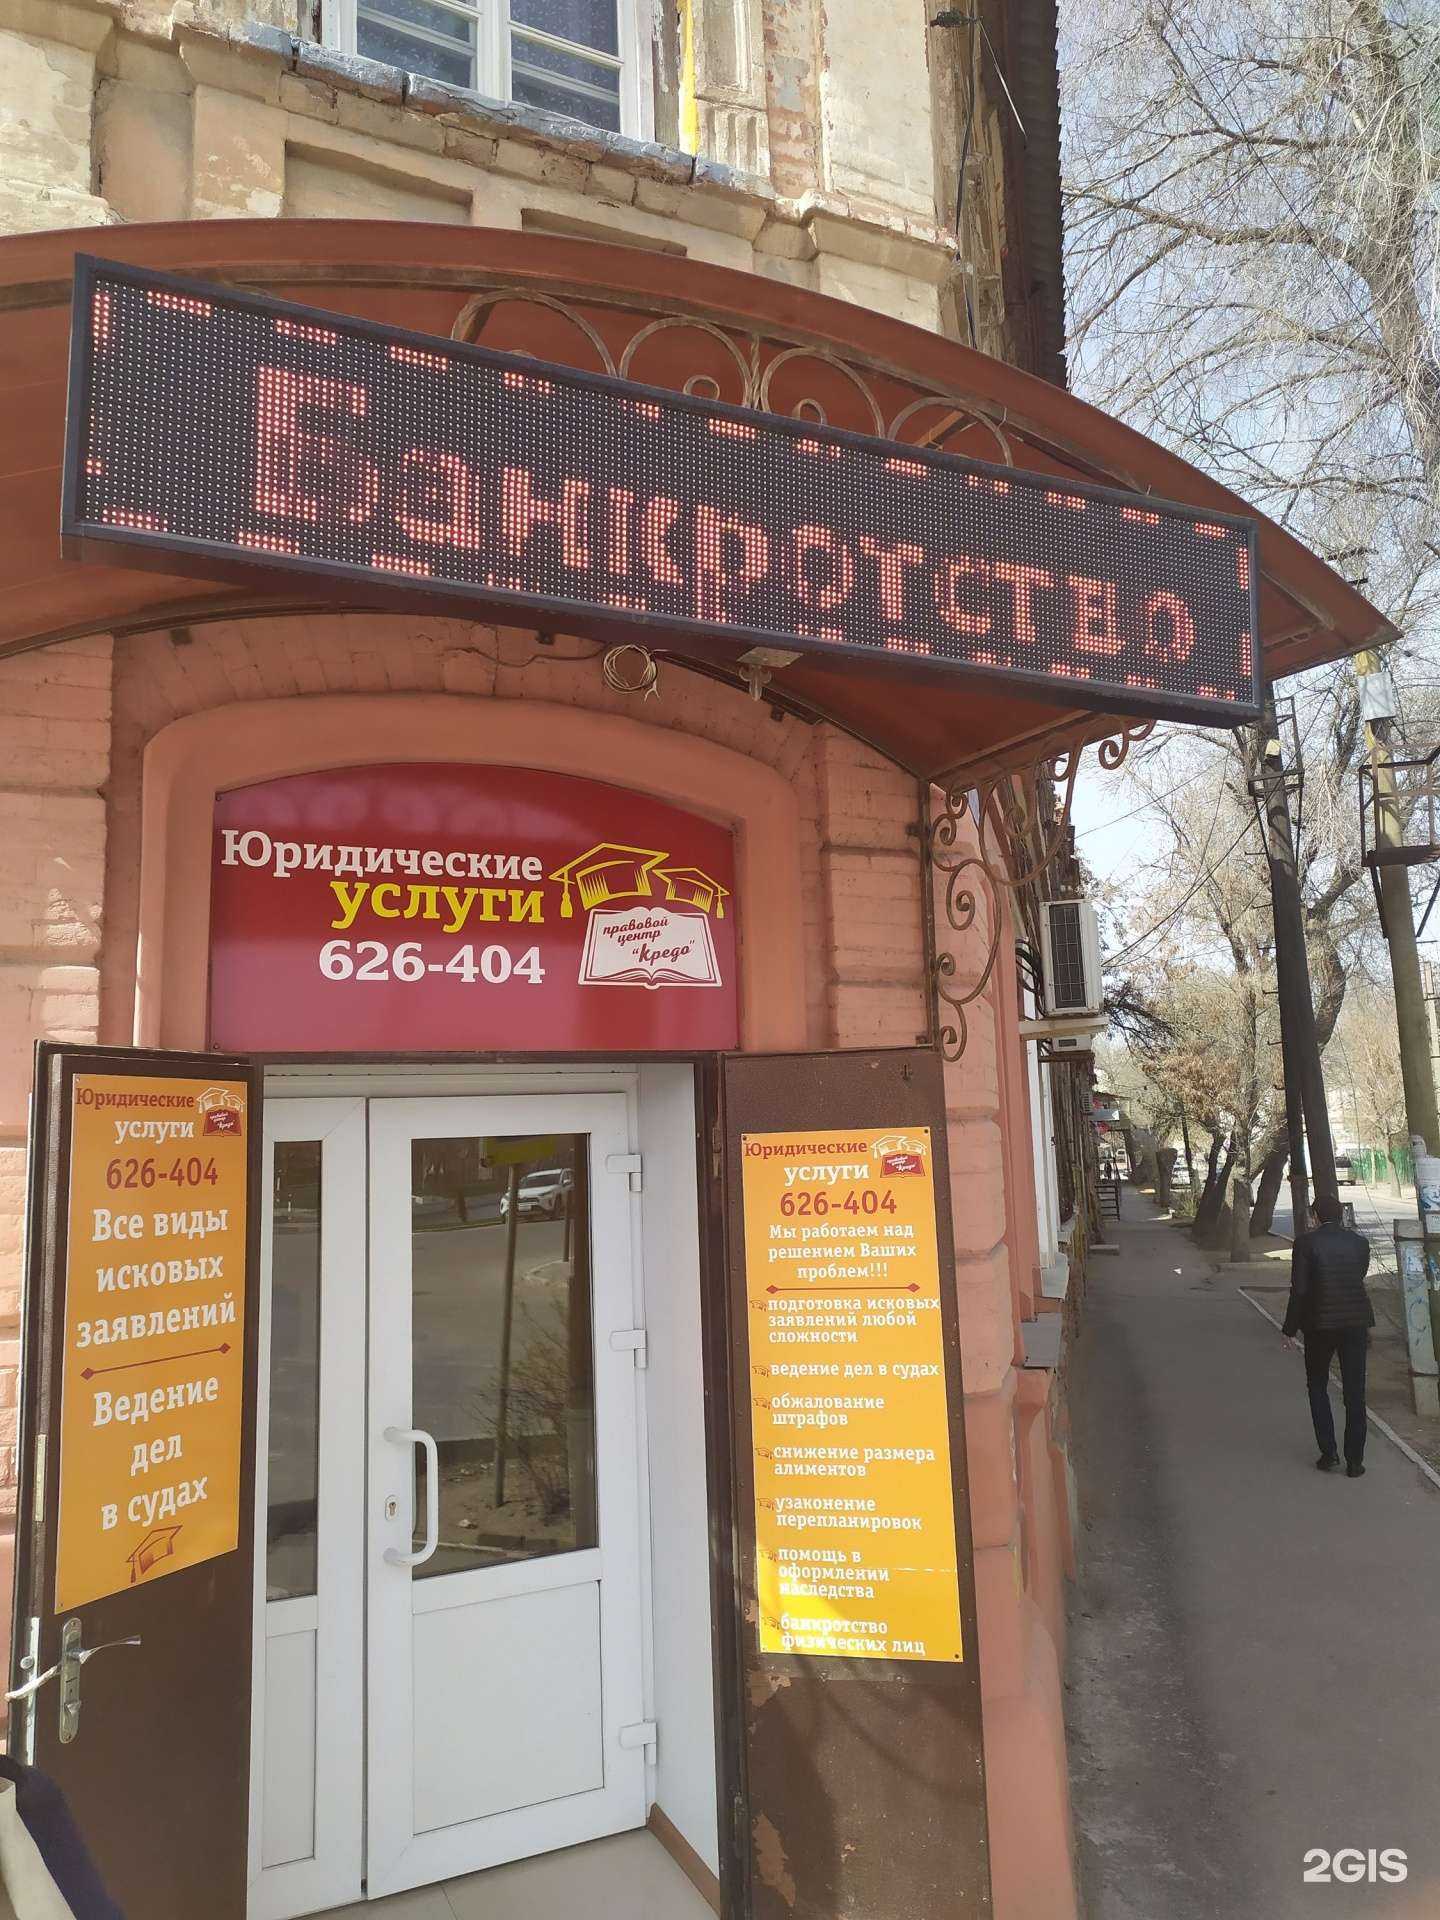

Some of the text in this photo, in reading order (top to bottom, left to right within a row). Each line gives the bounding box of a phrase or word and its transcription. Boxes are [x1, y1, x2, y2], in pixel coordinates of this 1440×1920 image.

[255, 365, 1197, 664] Банкротство
[221, 829, 543, 881] Юридические
[330, 881, 545, 933] услуги
[603, 917, 670, 938] правовой
[618, 930, 662, 946] центр
[318, 939, 546, 985] 626-404
[75, 1087, 195, 1111] Юридические
[114, 1120, 194, 1144] услуги
[744, 1141, 868, 1160] Юридические
[106, 1157, 218, 1189] 626-404
[784, 1164, 870, 1187] услуги
[780, 1189, 898, 1217] 626-404
[91, 1208, 228, 1242] Все виды
[769, 1222, 914, 1242] Мы работаем над
[768, 1242, 917, 1262] решением Ваших
[96, 1255, 224, 1293] исковых
[797, 1262, 888, 1282] проблем!!!
[768, 1297, 941, 1313] подготовка исковых
[76, 1292, 236, 1348] заявлений
[769, 1310, 917, 1327] заявлений любой
[769, 1331, 858, 1343] сложности
[770, 1363, 940, 1379] ведение дел в судах
[93, 1376, 219, 1427] Ведение
[771, 1392, 885, 1409] обжалование
[772, 1410, 848, 1429] штрафов
[130, 1433, 183, 1476] дел
[773, 1446, 935, 1464] снижение размера
[774, 1462, 866, 1477] алиментов
[101, 1476, 208, 1531] в судах
[775, 1497, 876, 1513] узаконение
[776, 1514, 923, 1532] перепланировок
[778, 1548, 861, 1563] помощь в
[892, 1640, 926, 1655] лиц
